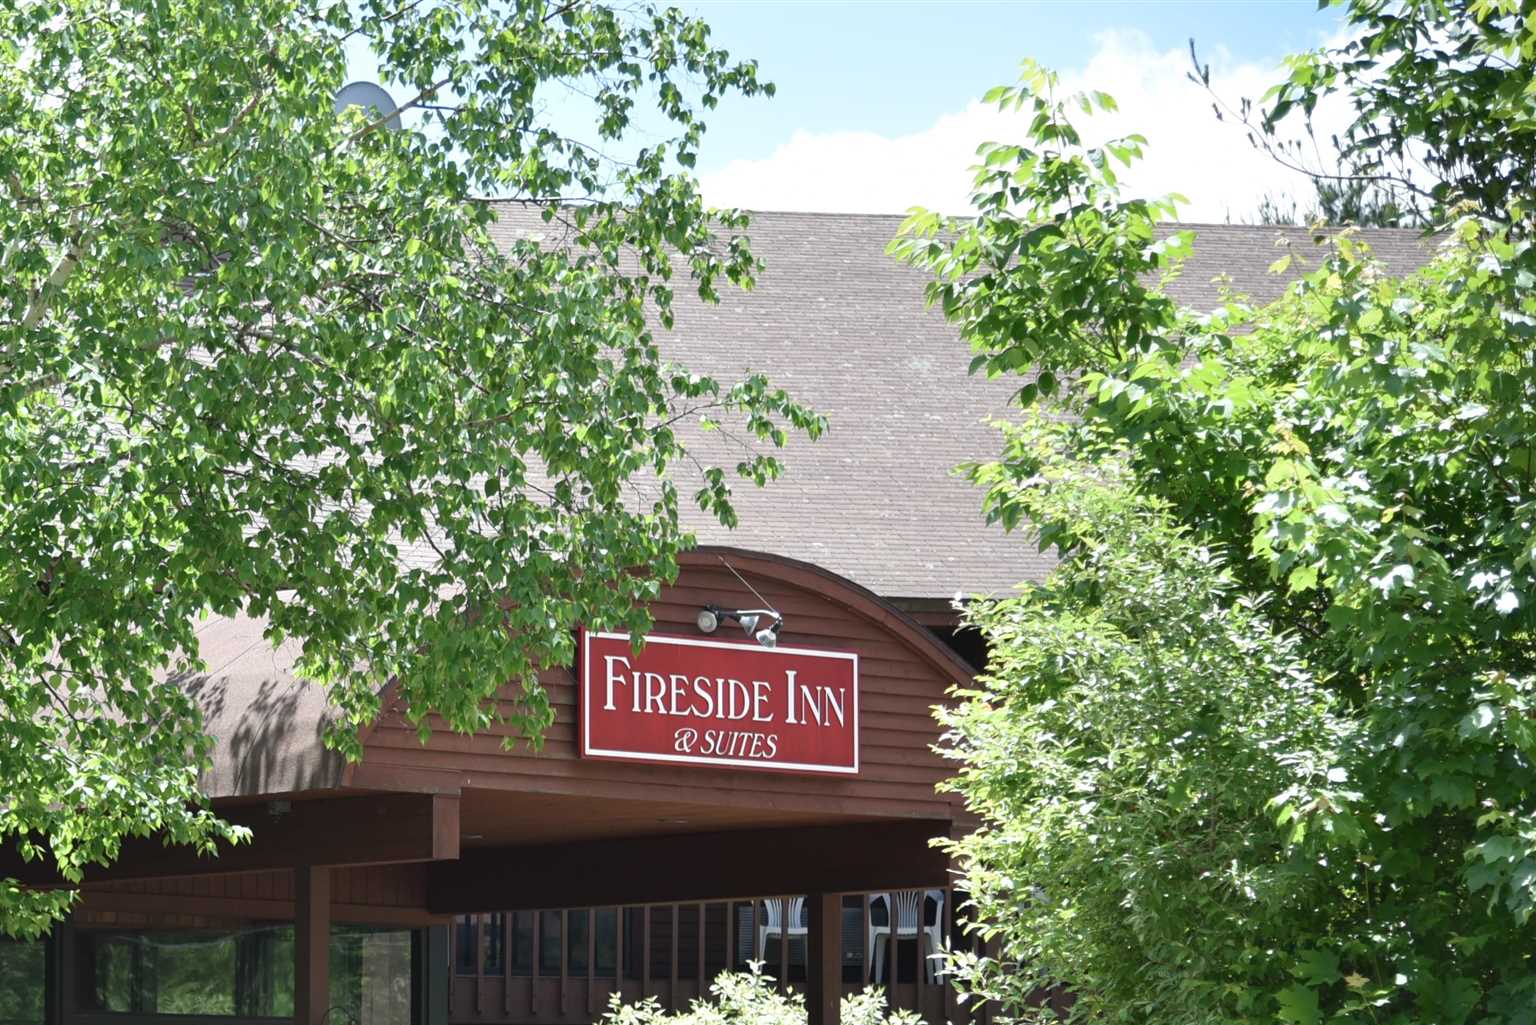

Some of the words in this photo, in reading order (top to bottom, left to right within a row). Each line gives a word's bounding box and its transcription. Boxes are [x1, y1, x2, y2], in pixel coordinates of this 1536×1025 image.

[603, 655, 774, 722] FIRESIDE
[785, 670, 846, 728] INN
[674, 728, 698, 752] &
[700, 730, 778, 758] SUITES
